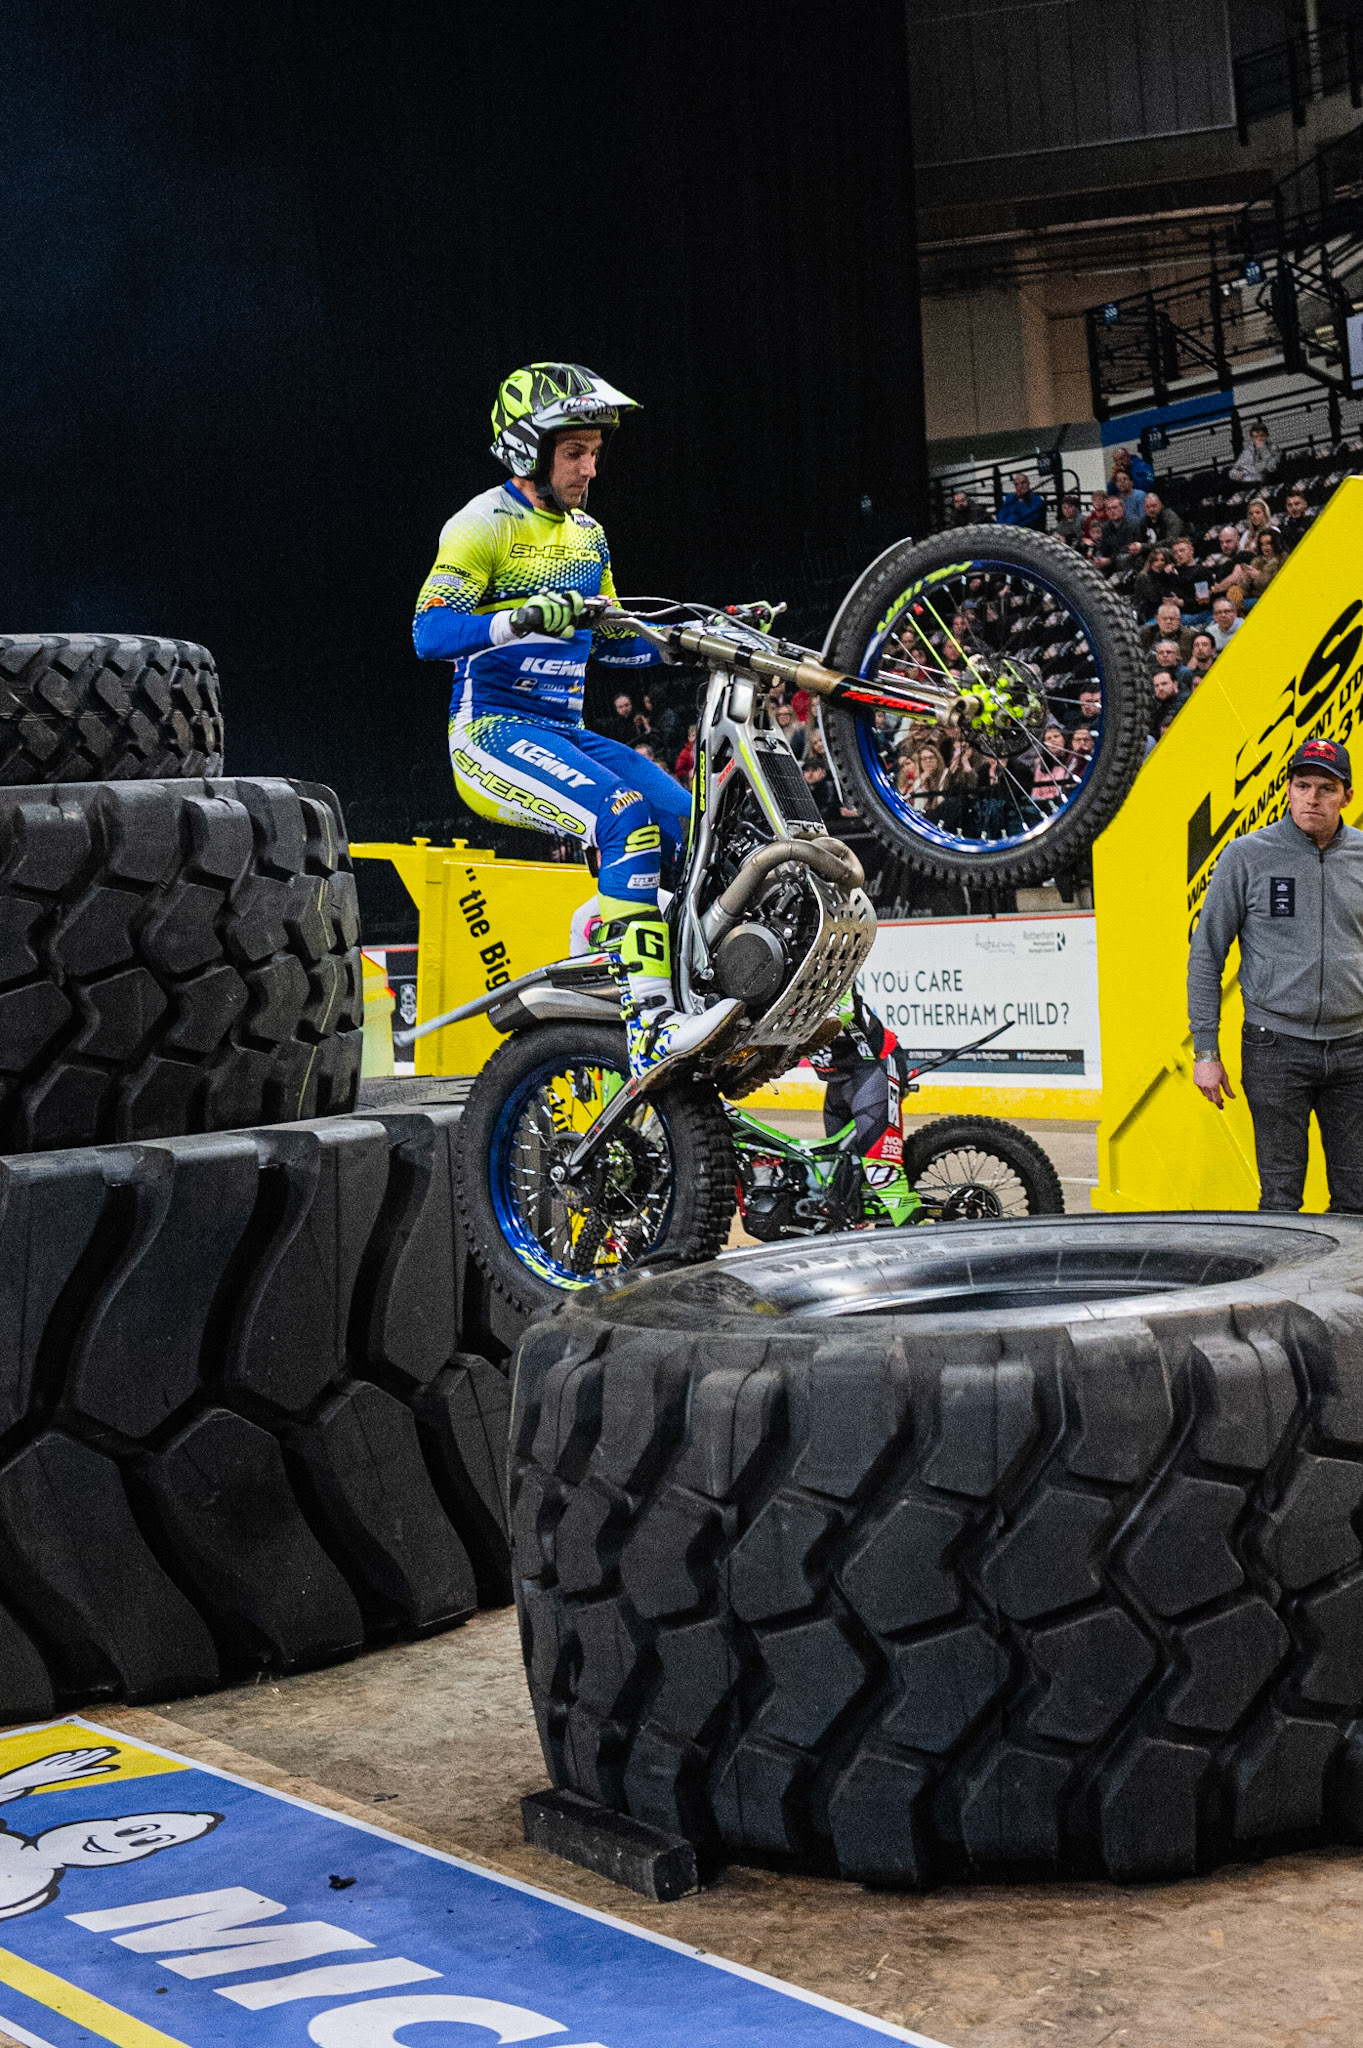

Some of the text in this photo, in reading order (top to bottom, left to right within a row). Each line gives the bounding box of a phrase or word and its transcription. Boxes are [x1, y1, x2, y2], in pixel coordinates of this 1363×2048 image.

[510, 543, 601, 563] SHERCO
[519, 656, 587, 678] KENN
[506, 738, 597, 789] KENNY
[451, 748, 587, 835] SHERCO
[915, 969, 964, 992] CARE
[886, 1002, 997, 1026] ROTHERHAM
[1003, 1002, 1069, 1025] CHILD?
[65, 1886, 610, 2048] MIC
